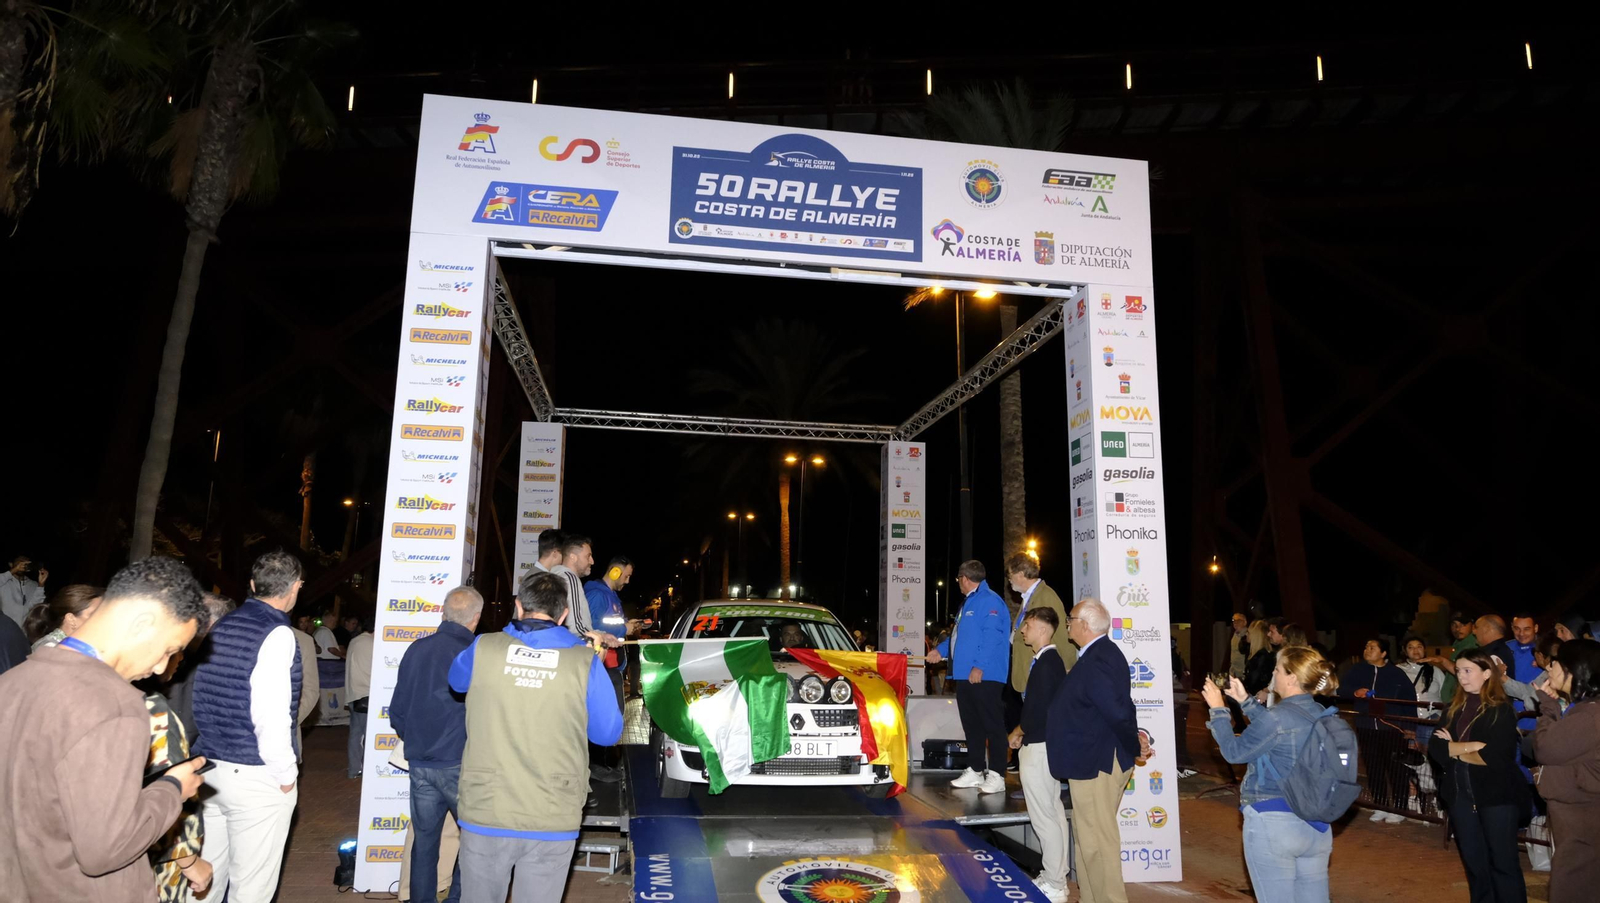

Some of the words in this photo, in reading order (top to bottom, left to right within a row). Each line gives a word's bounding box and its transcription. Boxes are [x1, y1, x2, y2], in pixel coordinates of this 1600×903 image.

[528, 190, 600, 208] CERA
[695, 172, 744, 198] 50
[747, 177, 901, 212] RALLYE
[541, 212, 586, 226] Recalvi
[694, 201, 766, 219] COSTA
[769, 207, 798, 222] DE
[802, 210, 897, 230] ALMERÍA
[968, 234, 1004, 246] COSTA
[1006, 238, 1020, 248] DE
[956, 246, 1022, 263] ALMERÍA
[1061, 244, 1132, 259] DIPUTACIÓN
[433, 264, 474, 272] MICHELIN
[1061, 254, 1077, 266] DE
[1079, 256, 1130, 270] ALMERÍA
[416, 304, 472, 318] Rallycar
[422, 331, 460, 342] Recalvi
[407, 399, 464, 414] Rallycar
[1100, 405, 1153, 421] MOYA
[413, 427, 452, 438] Recalvi
[1104, 440, 1124, 449] UNED
[526, 460, 555, 468] Rallycar
[1072, 468, 1092, 490] gasolia
[1103, 467, 1155, 482] gasolia
[398, 497, 456, 511] Rallycar
[404, 525, 444, 537] Recalvi
[1074, 529, 1095, 544] Phonika
[1106, 524, 1158, 540] Phonika
[892, 543, 921, 552] gasolia
[892, 575, 921, 584] Phonika
[693, 616, 720, 631] 21
[504, 666, 558, 680] FOTO/TV
[514, 678, 543, 688] 2025
[807, 742, 832, 756] BLT
[372, 817, 410, 830] Rally
[766, 862, 854, 886] AUTOMOVIL
